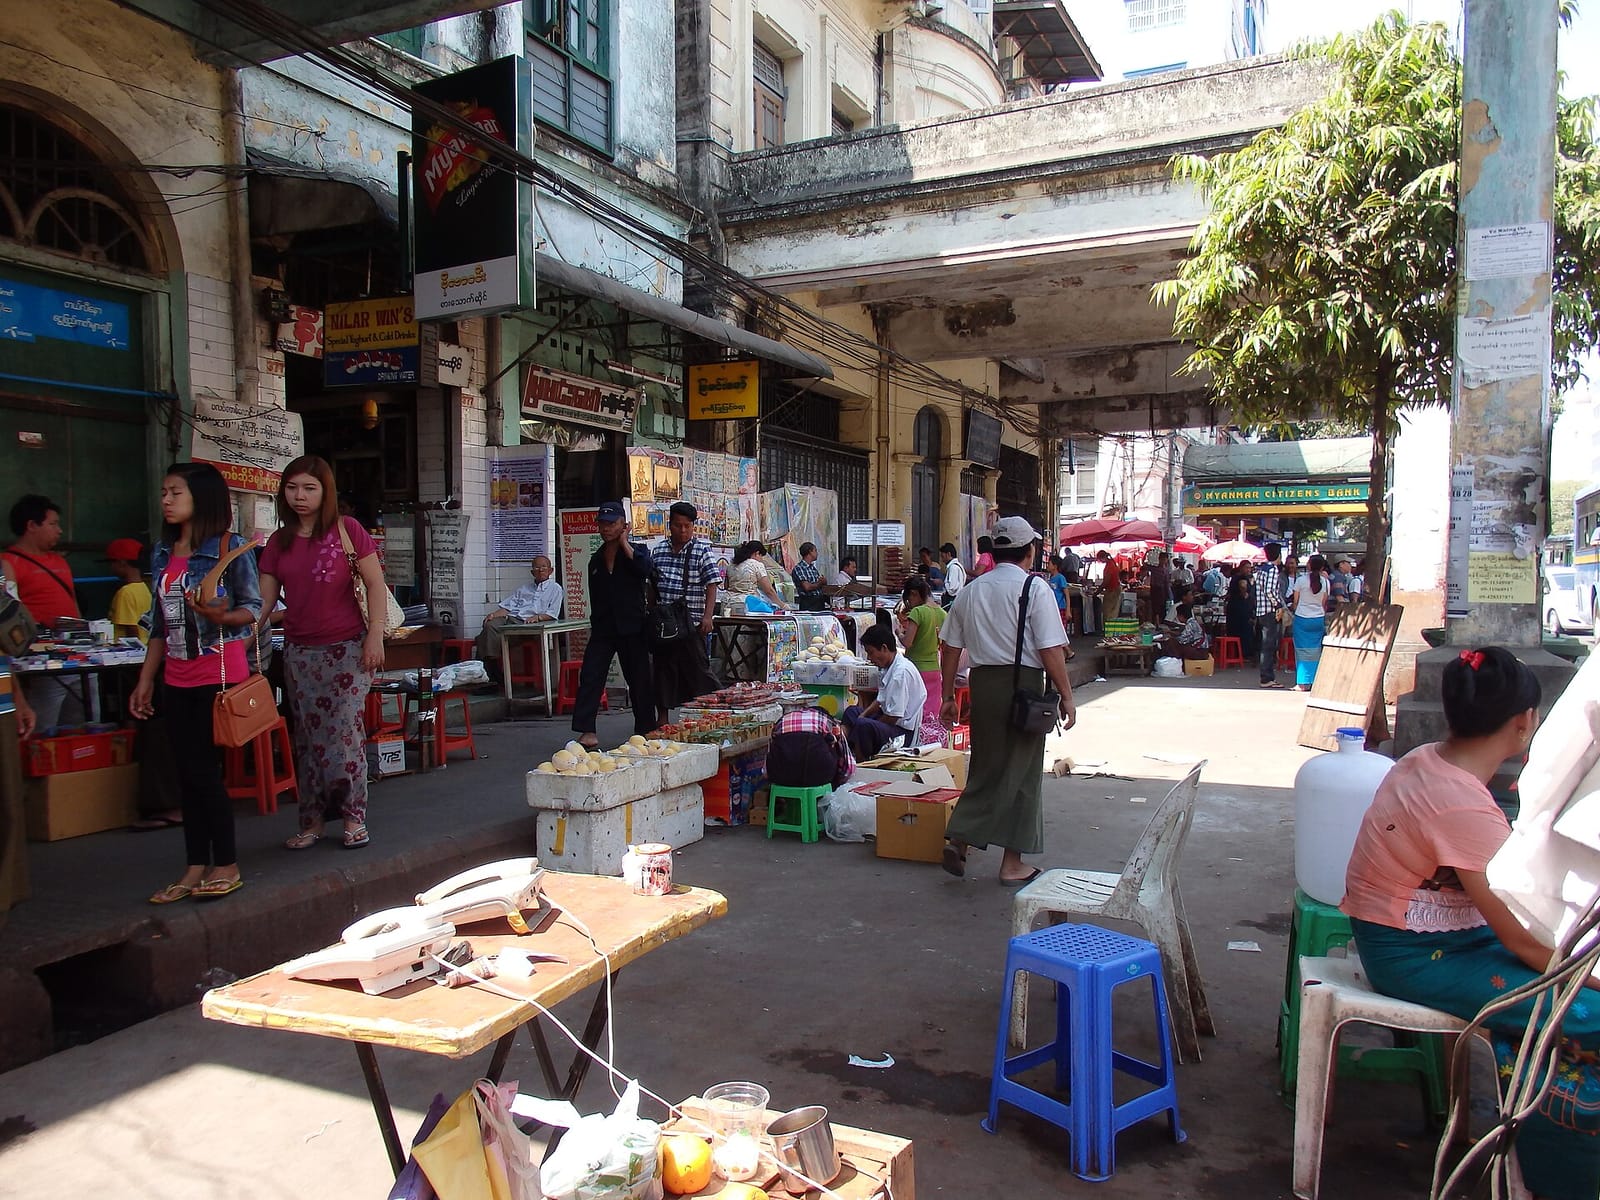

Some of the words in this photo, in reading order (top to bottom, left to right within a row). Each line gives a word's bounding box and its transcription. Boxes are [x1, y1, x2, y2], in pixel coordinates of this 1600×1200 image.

[331, 312, 369, 330] NILAR
[376, 306, 413, 326] WIN'S
[1205, 491, 1259, 501] MYANMAR
[1265, 489, 1320, 498] CITIZENS
[1328, 488, 1360, 497] BANK
[563, 512, 589, 525] NILAR
[567, 523, 588, 534] Special
[382, 750, 401, 763] TPS
